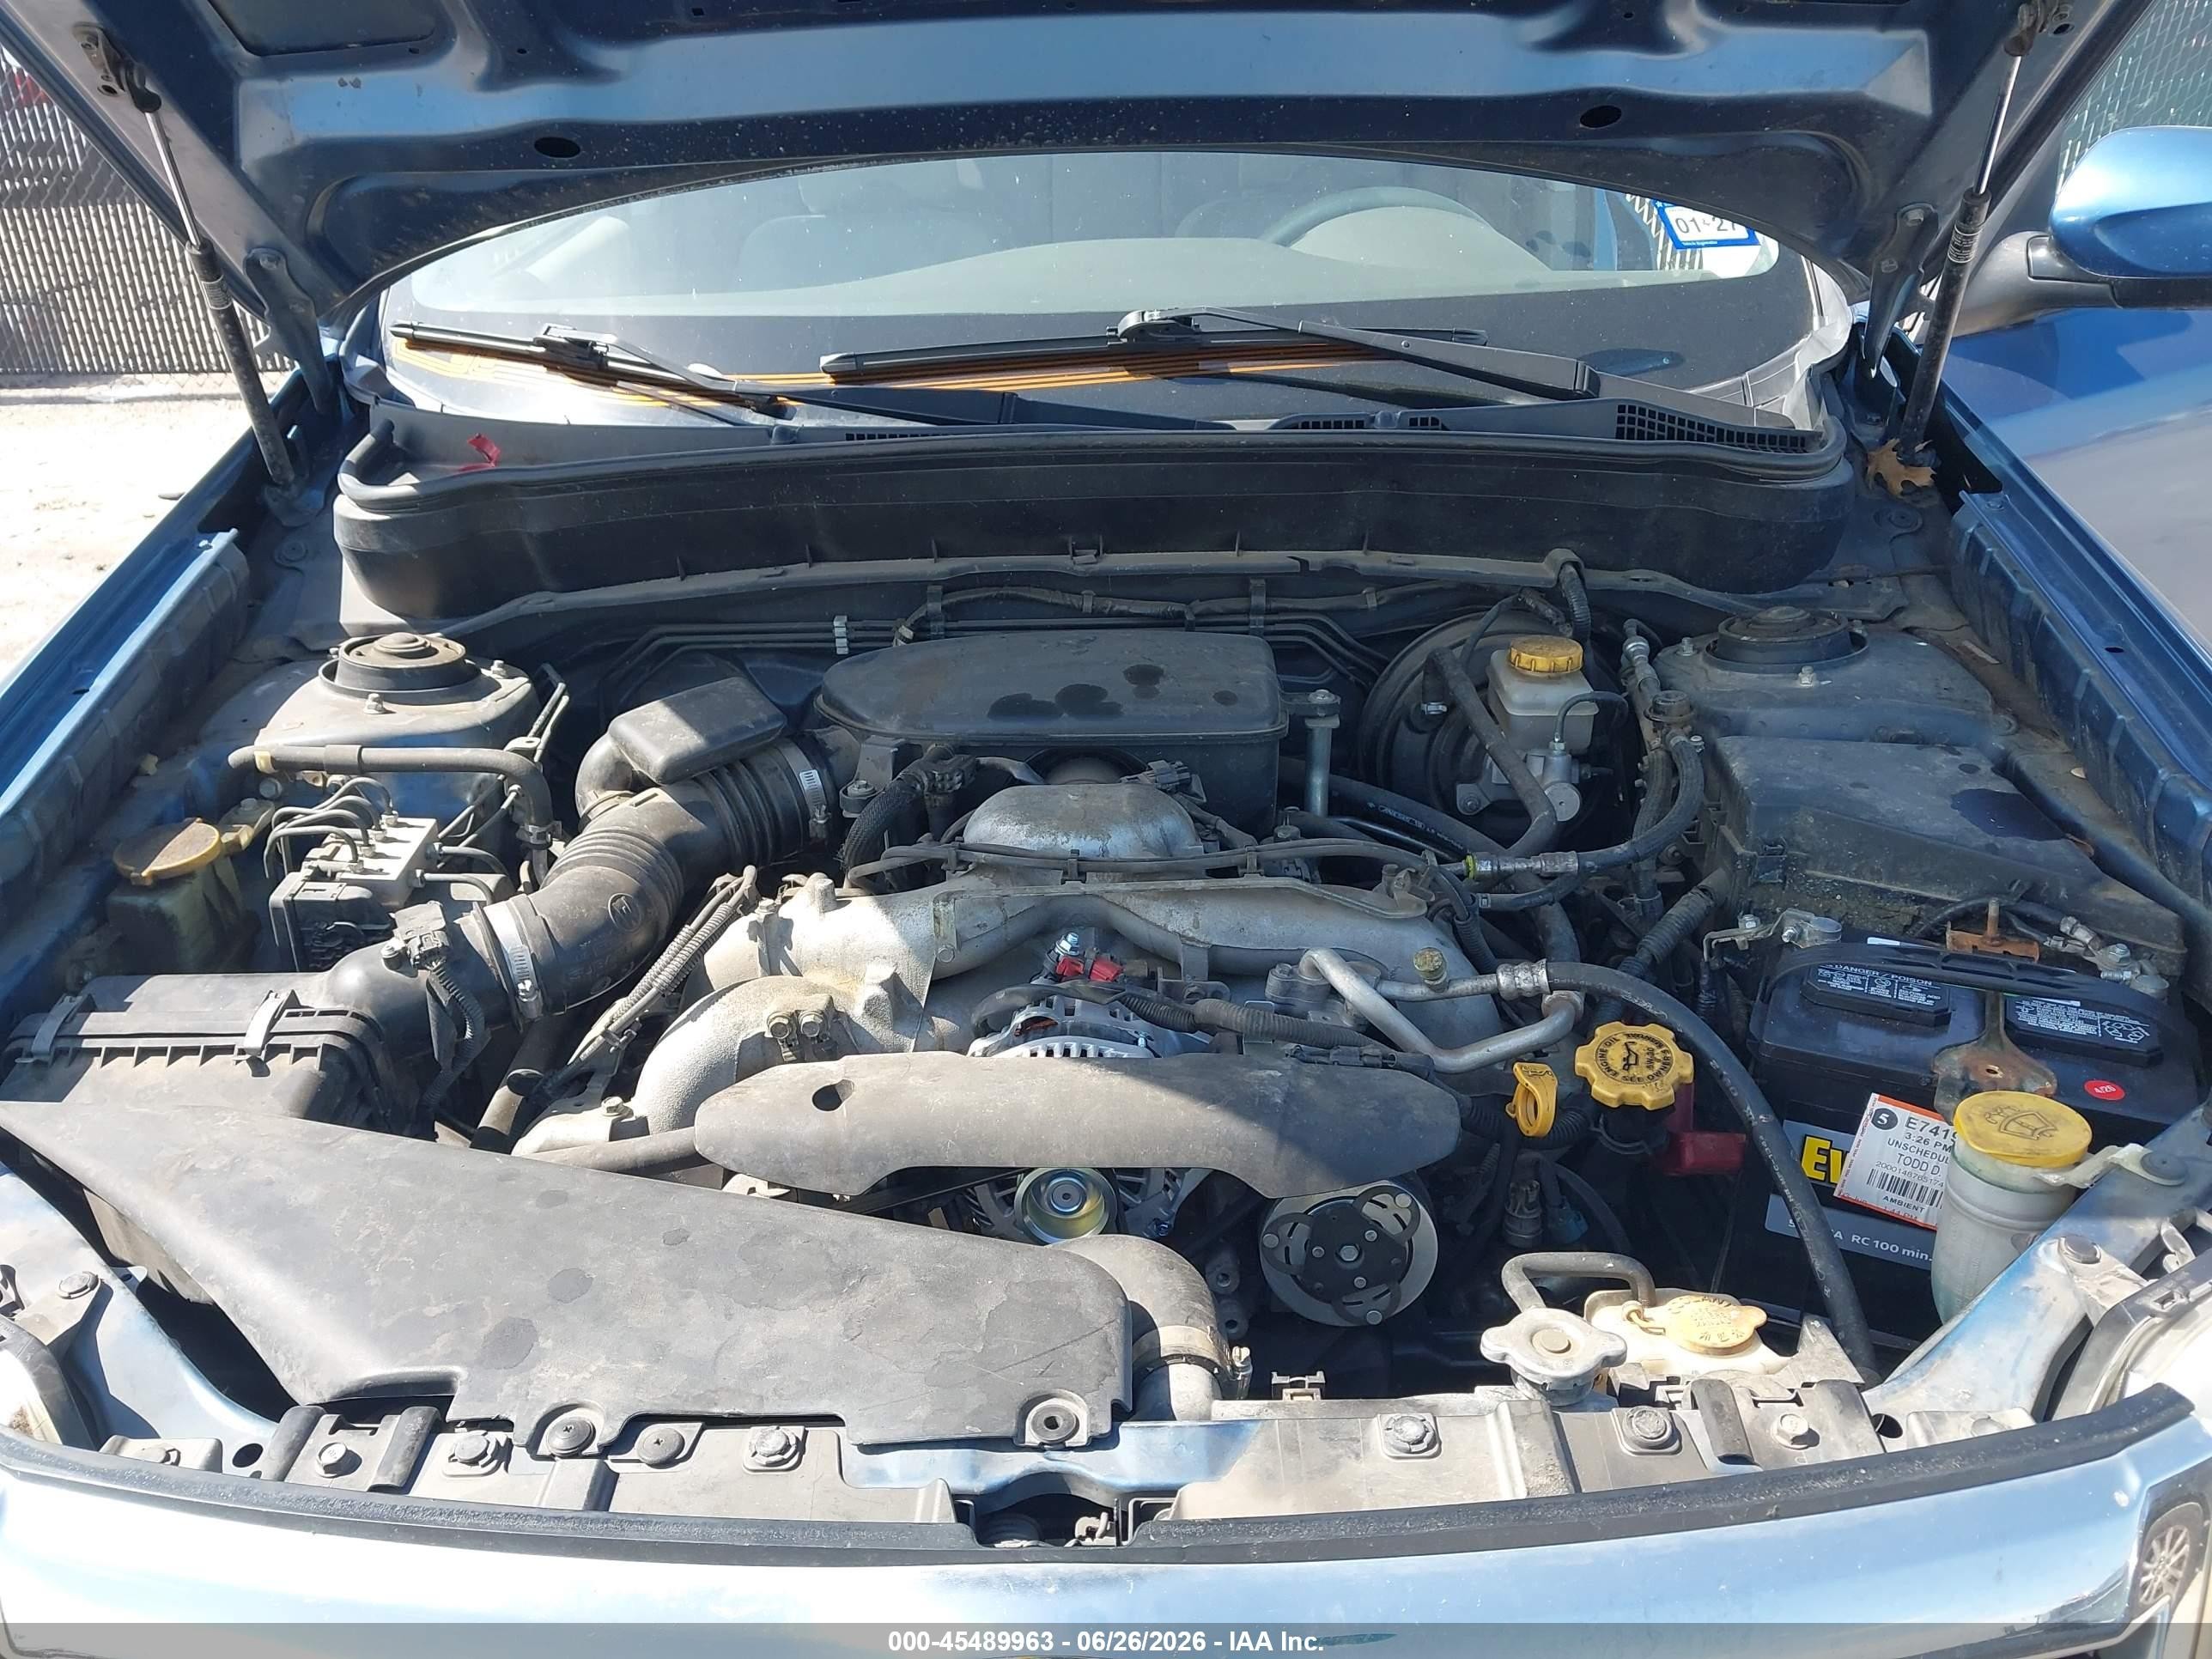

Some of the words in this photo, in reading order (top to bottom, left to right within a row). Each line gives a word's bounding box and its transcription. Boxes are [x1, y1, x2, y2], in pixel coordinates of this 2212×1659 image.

[1833, 963, 1881, 976] DANGER
[1891, 974, 1933, 986] POISON
[1604, 1036, 1620, 1048] OIL
[1599, 1048, 1620, 1078] ENGINE
[1877, 1113, 1890, 1125] 5
[1905, 1132, 1930, 1146] 3:26
[1934, 1141, 1952, 1153] PM
[1897, 1153, 1929, 1173] TODD
[1930, 1164, 1942, 1177] D.
[1882, 1195, 1925, 1213] AMBIENT
[1851, 1234, 1871, 1246] RC
[1873, 1240, 1899, 1254] 100
[1901, 1248, 1933, 1261] min.
